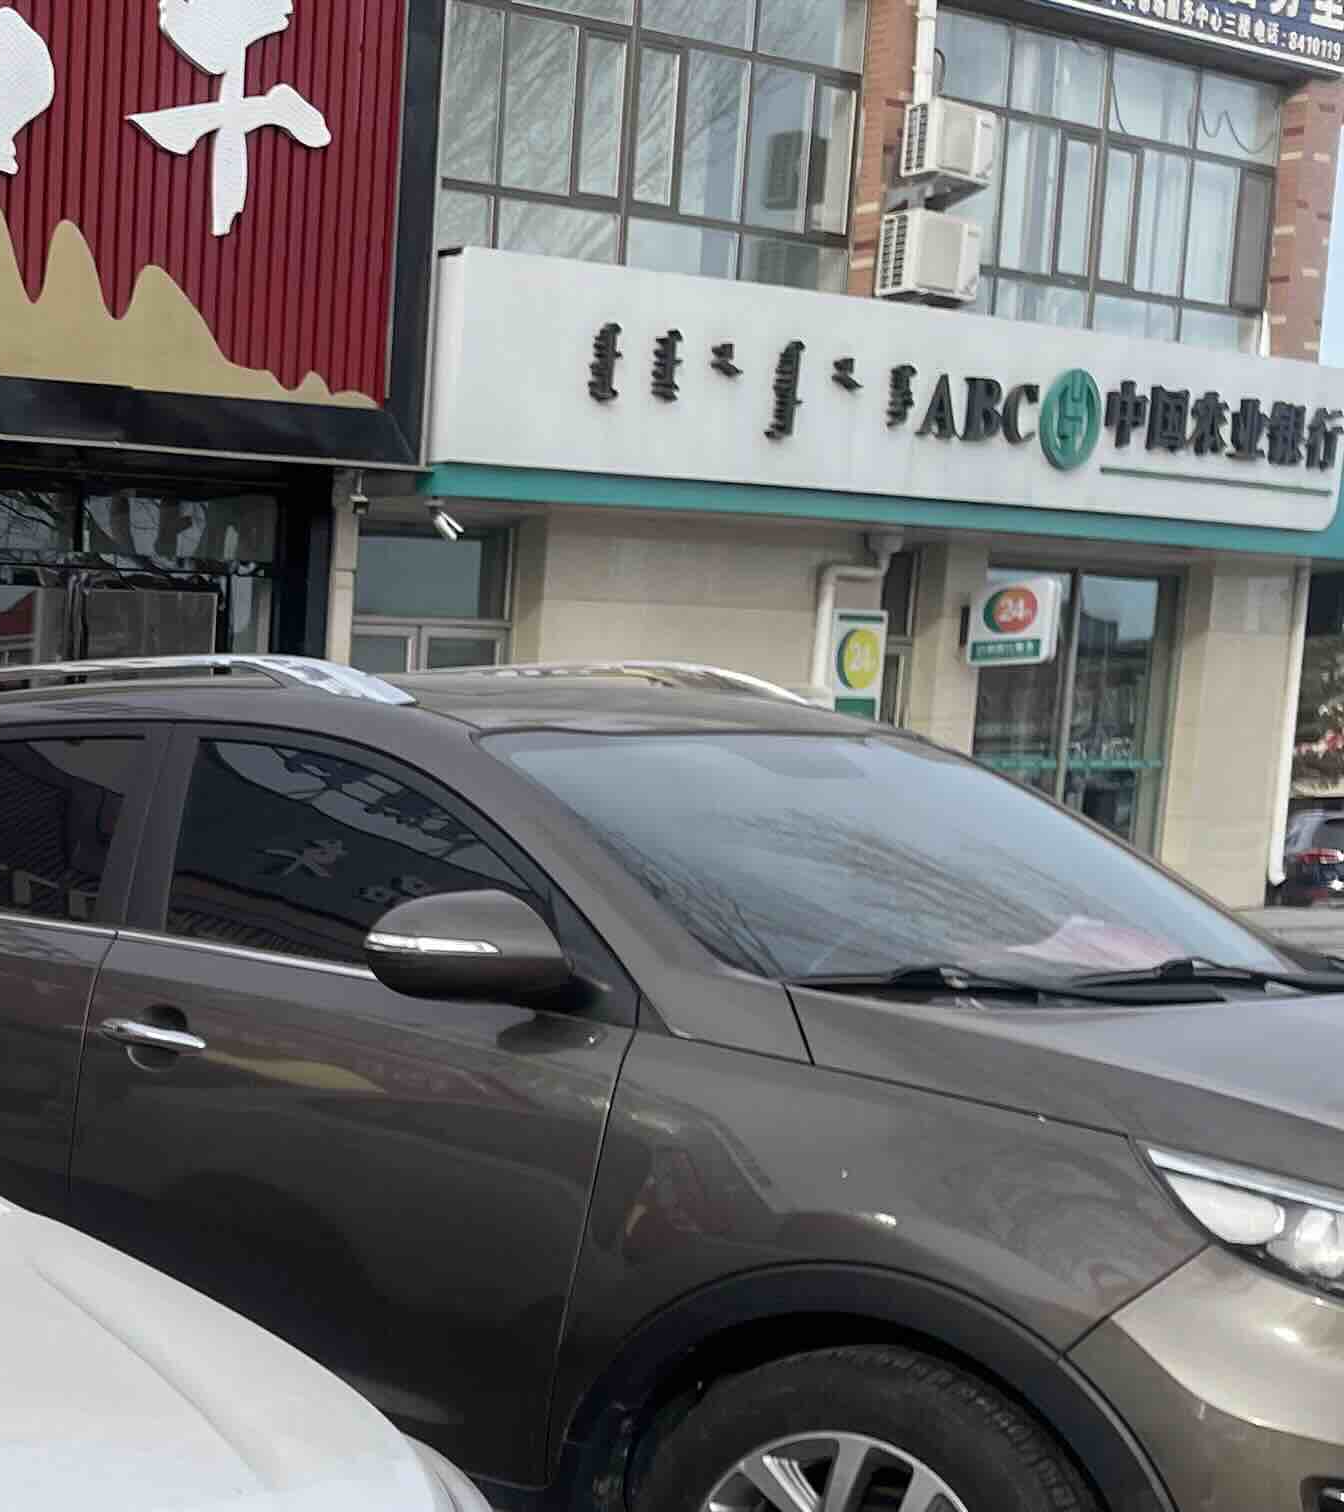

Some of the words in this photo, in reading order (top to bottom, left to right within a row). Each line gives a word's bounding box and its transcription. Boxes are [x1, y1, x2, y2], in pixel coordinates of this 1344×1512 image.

[915, 373, 1040, 443] ABC
[1105, 379, 1344, 471] 中国农业银行
